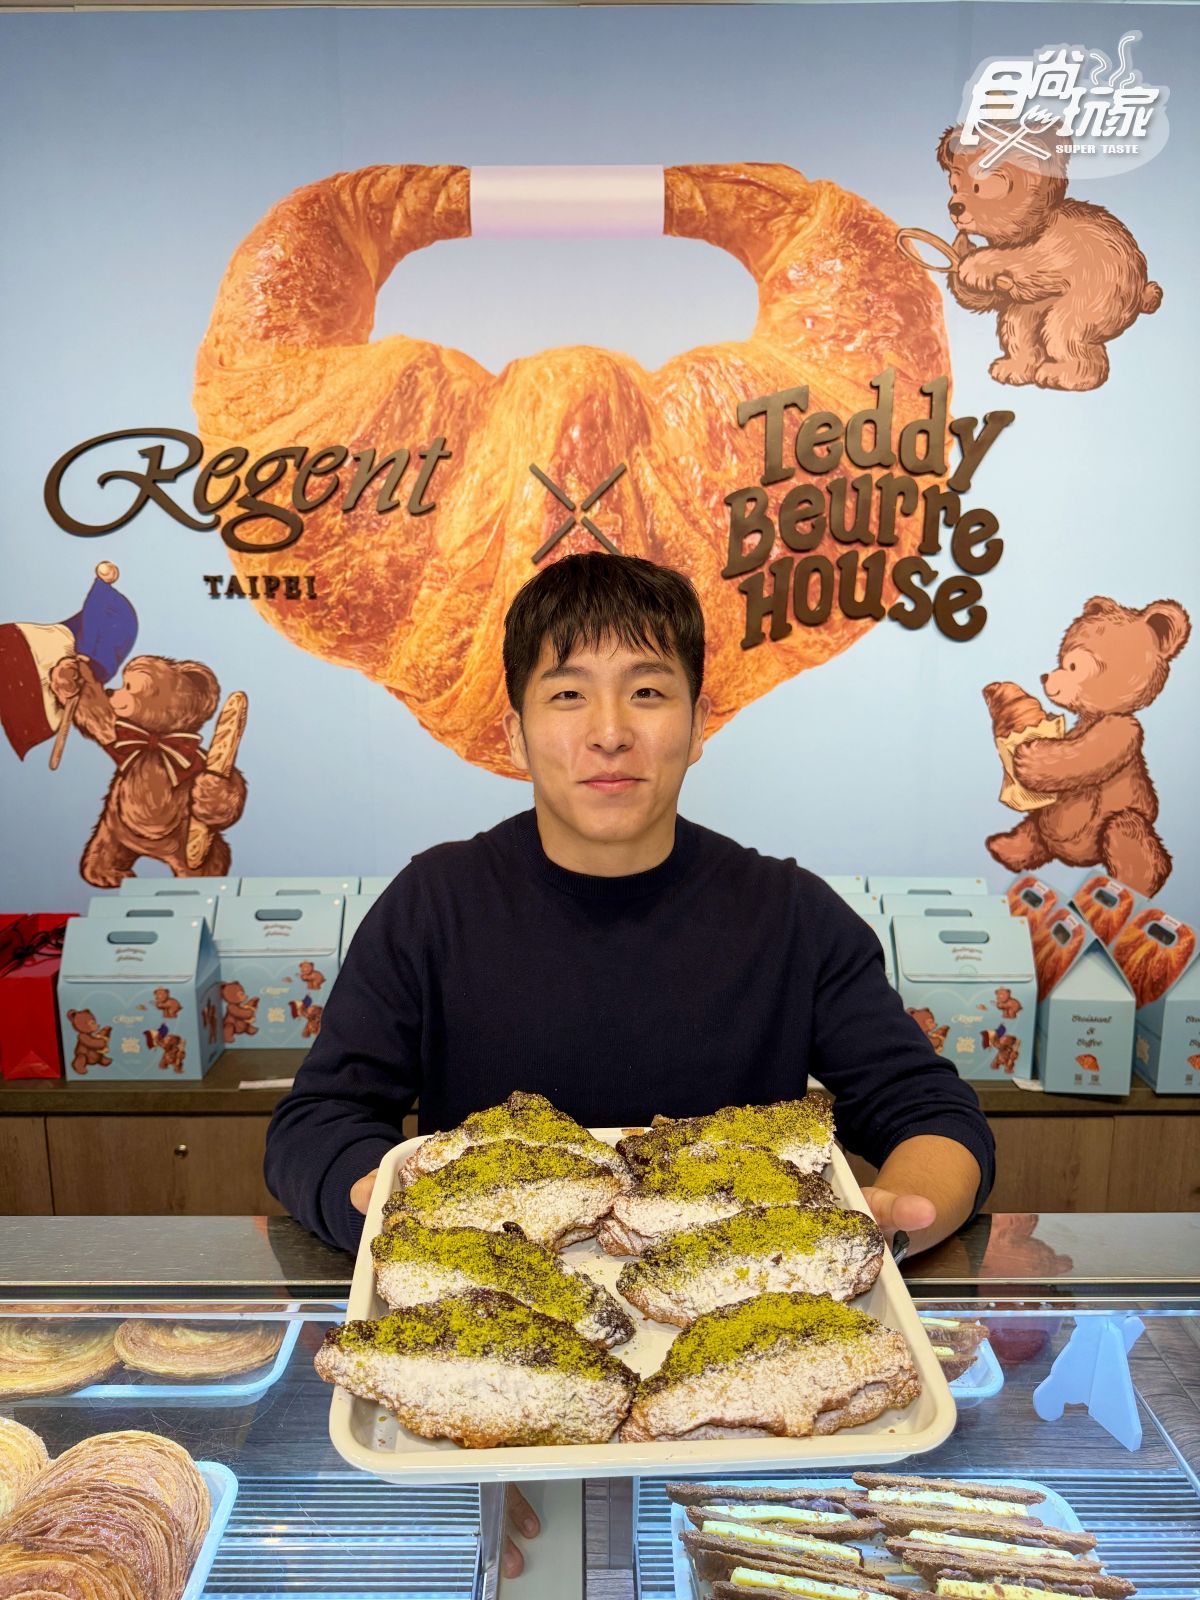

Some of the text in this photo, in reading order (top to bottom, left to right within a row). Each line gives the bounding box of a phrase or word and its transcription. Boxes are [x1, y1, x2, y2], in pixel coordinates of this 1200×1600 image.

[737, 368, 1015, 493] Teddy
[43, 427, 452, 553] Regent
[721, 473, 1004, 576] Beurre
[203, 575, 318, 600] TAIPEI
